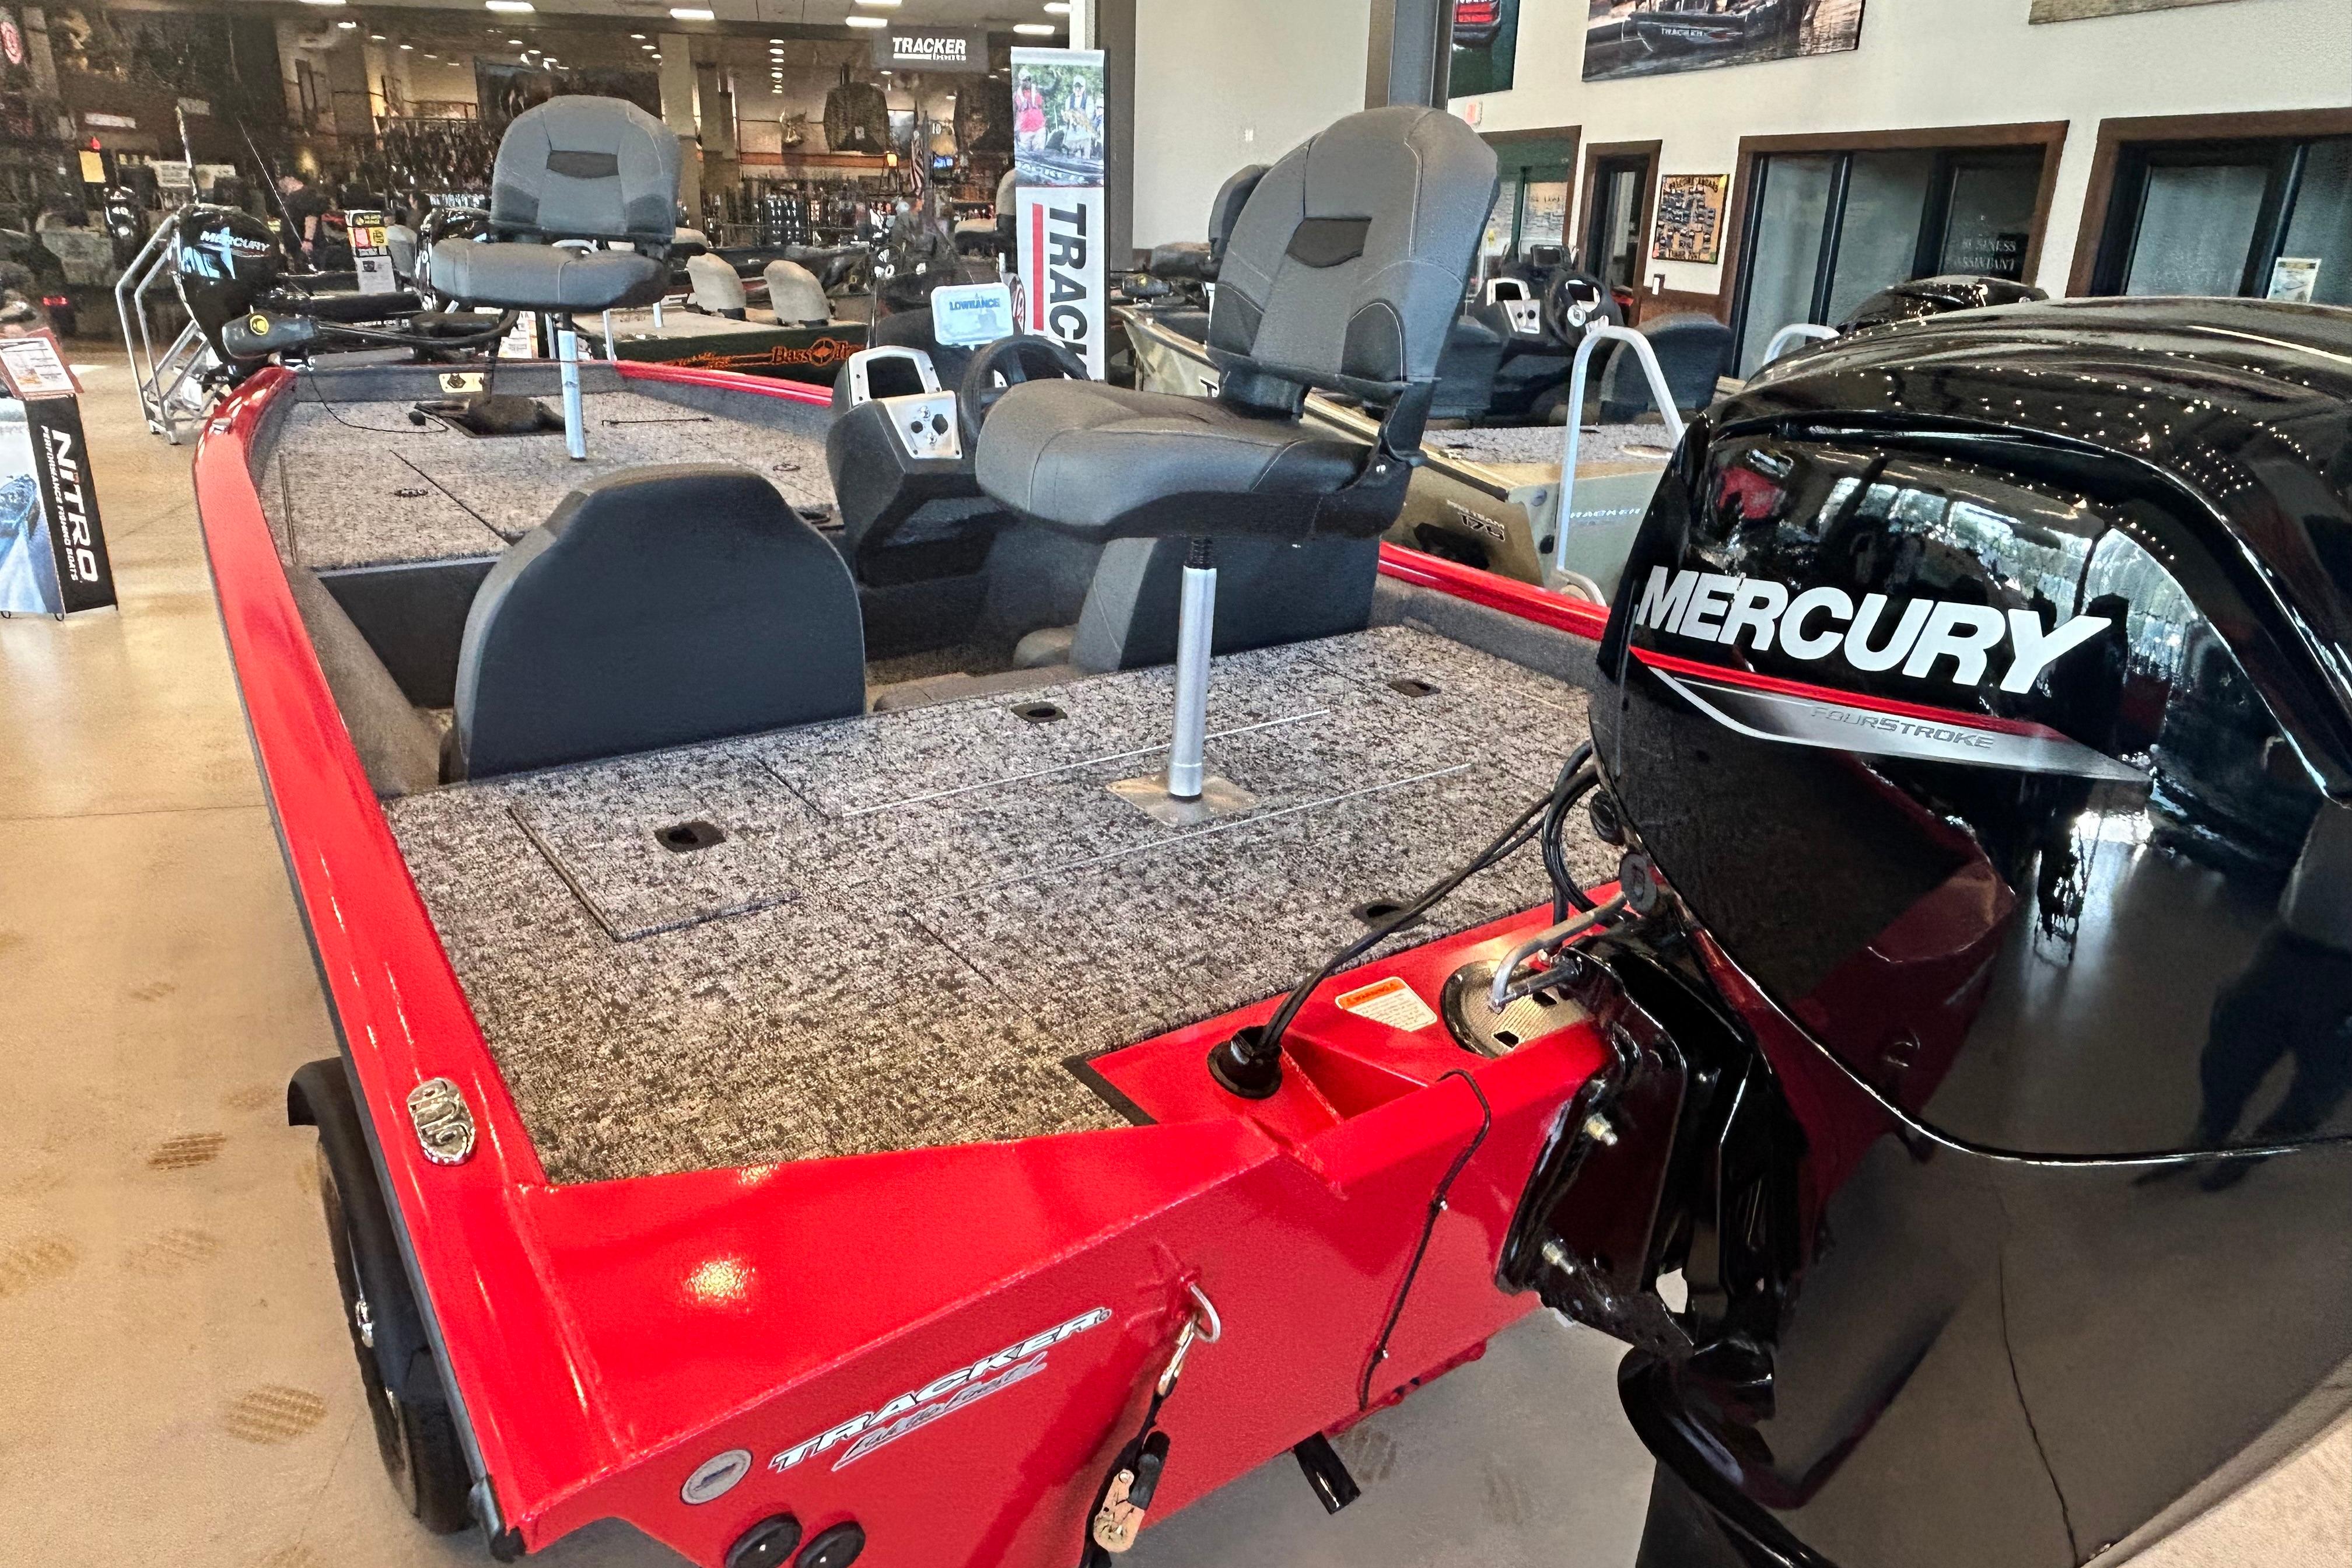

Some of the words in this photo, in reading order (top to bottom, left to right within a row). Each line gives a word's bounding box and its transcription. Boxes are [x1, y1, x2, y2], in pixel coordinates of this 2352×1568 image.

[892, 37, 966, 54] TRACKER
[949, 298, 1000, 311] LOWRANCE
[41, 425, 63, 508] PERFORMANCE
[57, 505, 71, 546] FISHING
[65, 547, 79, 582] BOATS
[1633, 566, 2111, 695] MERCURY
[1811, 706, 1994, 750] FOURSTROKE
